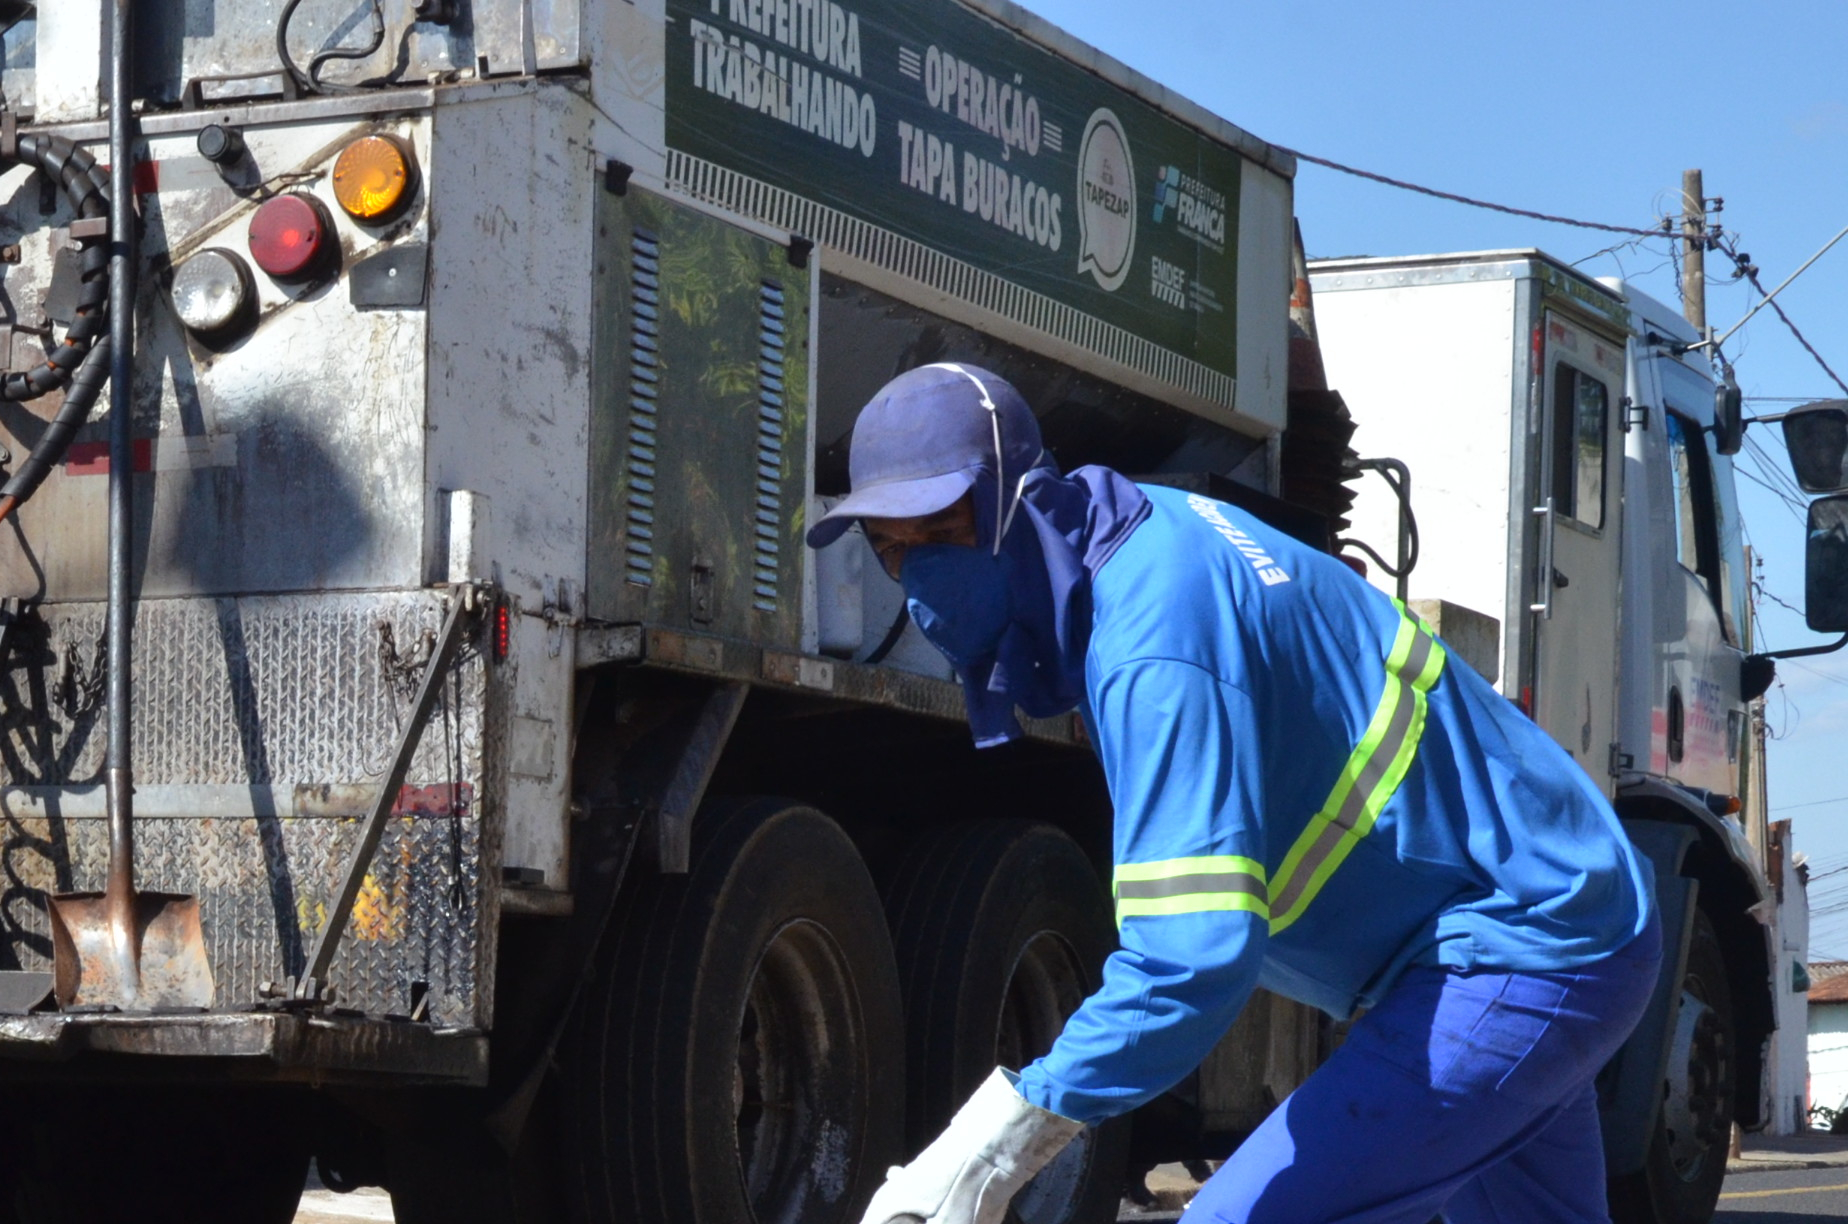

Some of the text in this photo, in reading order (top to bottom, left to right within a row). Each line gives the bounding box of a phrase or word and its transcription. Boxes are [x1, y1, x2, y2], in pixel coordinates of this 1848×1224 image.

[711, 0, 862, 78] EFEITURA
[690, 18, 876, 158] TRABALHANDO
[925, 45, 1040, 161] OPERAÇÃO
[898, 120, 1062, 252] TAPA BURACOS
[1177, 191, 1225, 245] FRANCA
[1180, 173, 1226, 211] PREFEITURA
[1152, 255, 1185, 291] EMDEF
[1214, 526, 1291, 586] EVITE
